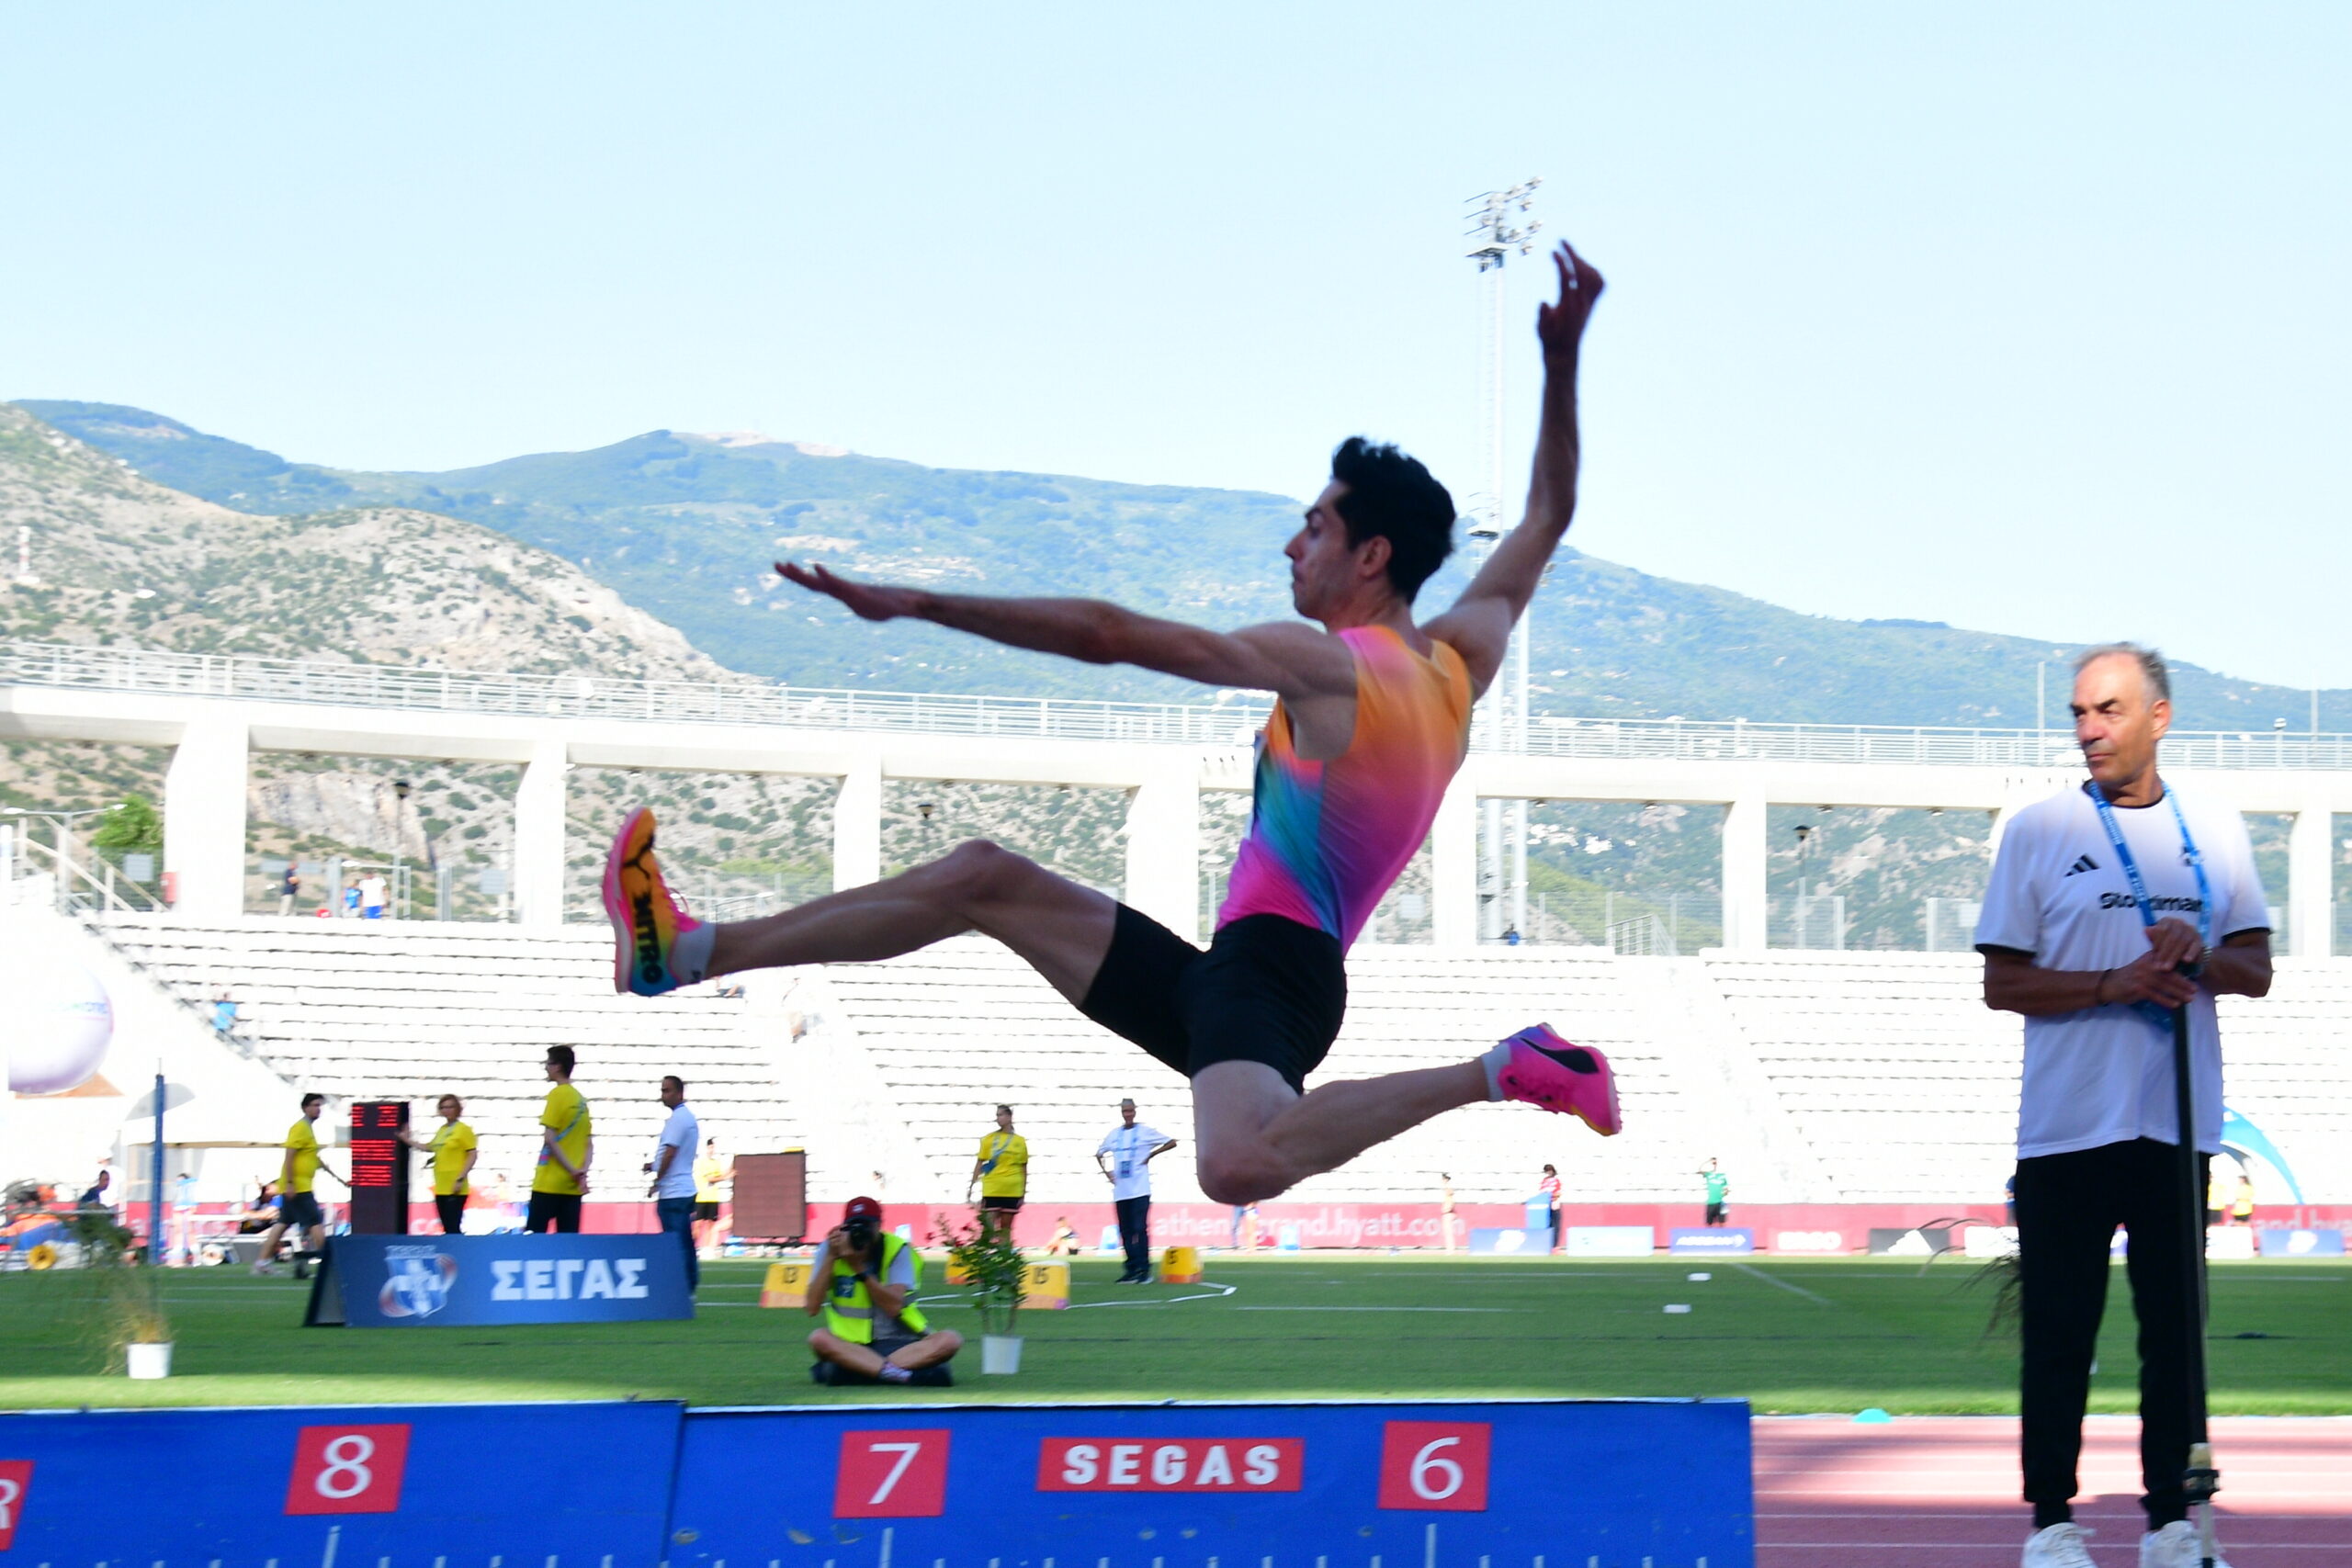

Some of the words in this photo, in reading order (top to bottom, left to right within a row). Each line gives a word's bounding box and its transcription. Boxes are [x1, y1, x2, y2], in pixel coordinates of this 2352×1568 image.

[491, 1258, 649, 1301] ΣΕΓΑΣ
[314, 1434, 376, 1499] 8
[868, 1442, 922, 1504] 7
[1062, 1444, 1281, 1485] SEGAS
[1409, 1437, 1464, 1500] 6
